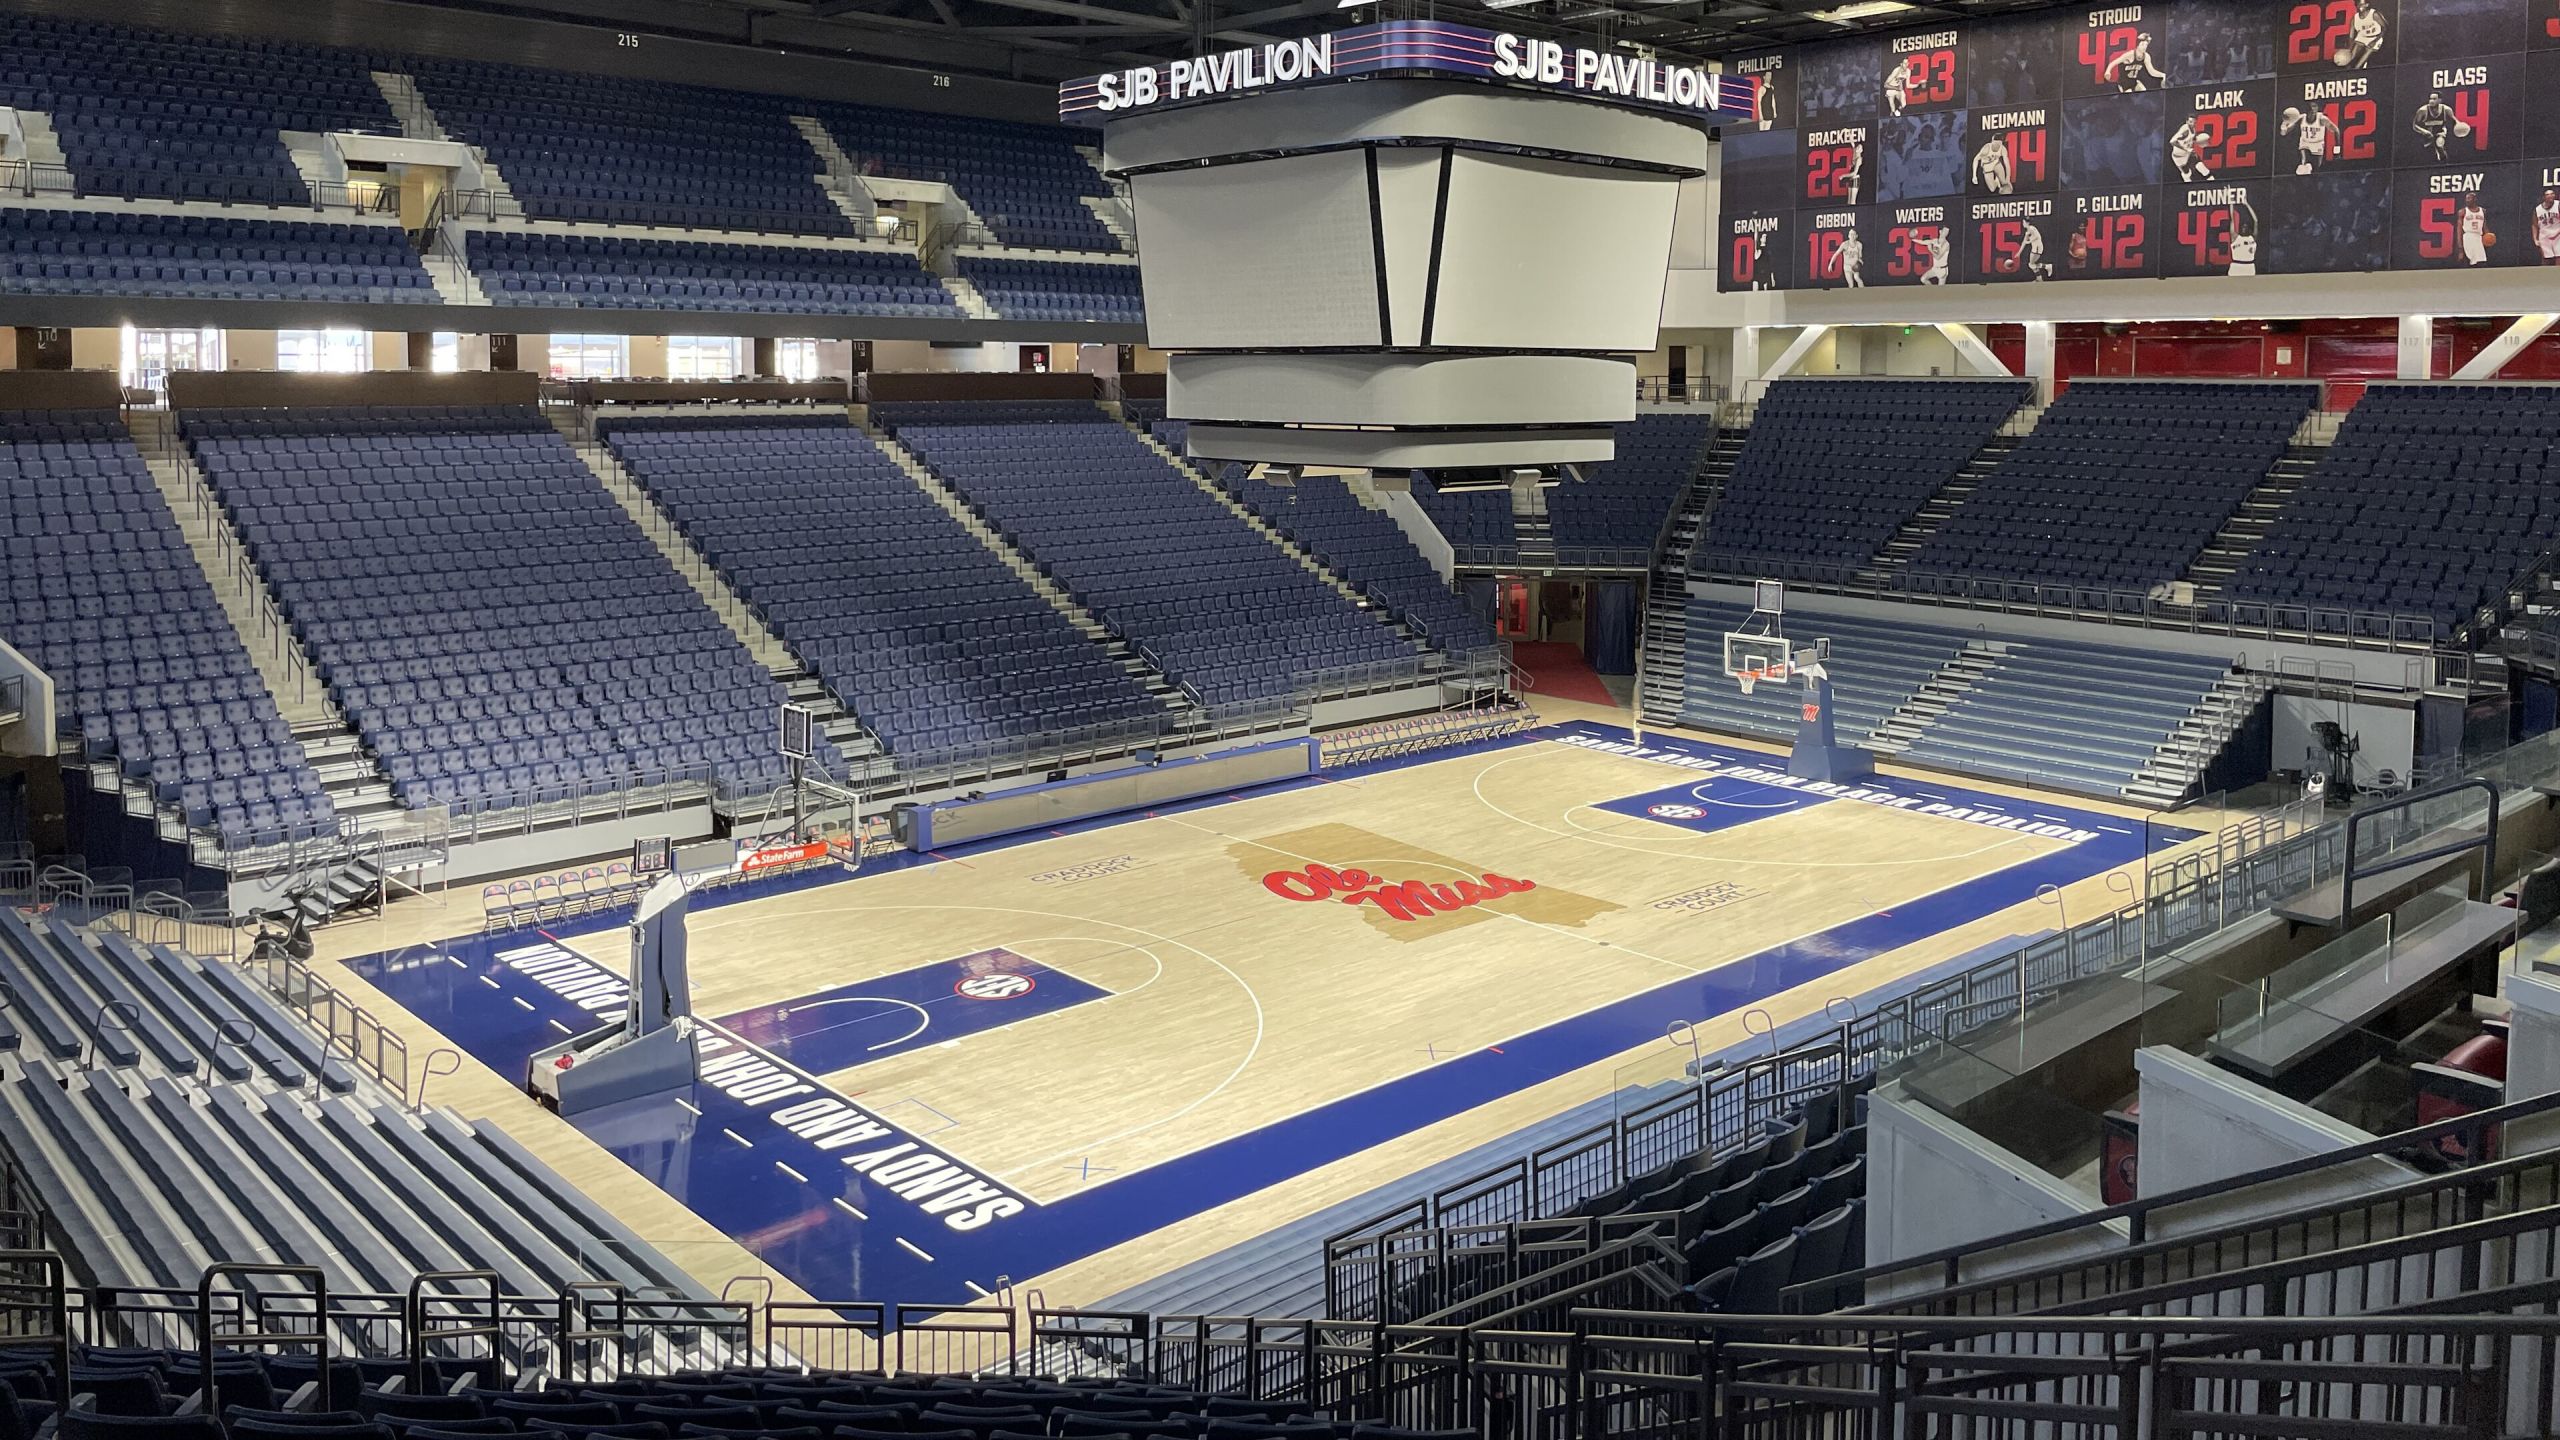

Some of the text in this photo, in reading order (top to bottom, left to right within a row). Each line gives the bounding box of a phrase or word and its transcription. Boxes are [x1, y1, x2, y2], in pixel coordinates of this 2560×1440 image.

[2088, 5, 2142, 28] STROUD
[618, 33, 639, 48] 215
[1892, 30, 1958, 53] KESSINGER
[2288, 0, 2357, 64] 22
[1737, 55, 1783, 75] PHILLIPS
[2078, 27, 2138, 84] 42
[933, 75, 950, 87] 216
[1098, 33, 1332, 111] SJB PAVILION
[1494, 33, 1564, 83] SJB
[1575, 48, 1720, 111] PAVILION
[1906, 50, 1955, 105] 23
[2433, 66, 2487, 89] GLASS
[2195, 90, 2245, 111] CLARK
[2304, 78, 2368, 101] BARNES
[1982, 110, 2045, 130] NEUMANN
[2323, 99, 2377, 161] 12
[2455, 89, 2490, 150] 4
[2193, 111, 2258, 169] 22
[2005, 129, 2047, 183] 14
[1808, 147, 1855, 198] 22
[2430, 173, 2485, 194] SESAY
[1972, 199, 2051, 220] SPRINGFIELD
[2092, 193, 2143, 212] GILLOM
[2187, 187, 2247, 207] CONNER
[1734, 217, 1778, 234] GRAHAM
[1815, 212, 1856, 229] GIBBON
[1896, 206, 1944, 224] WATERS
[2177, 209, 2240, 266] 43
[2419, 198, 2455, 258] 5
[1979, 220, 2023, 274] 15
[2086, 214, 2145, 270] 42
[1808, 231, 1844, 280] 16
[38, 329, 57, 342] 110
[1555, 734, 2100, 843] SANDY AND JOHN BLACK PAVILION
[1651, 804, 1703, 819] SEC
[1030, 855, 1140, 882] CRADDOCK
[1062, 863, 1131, 882] COURT
[1262, 864, 1383, 902] Ole
[1342, 872, 1537, 921] Miss
[1653, 882, 1744, 910] CRADDOCK
[1686, 891, 1745, 910] COURT
[961, 974, 1030, 998] SEC
[494, 942, 1025, 1231] SANDY AND JOHN PAVILION
